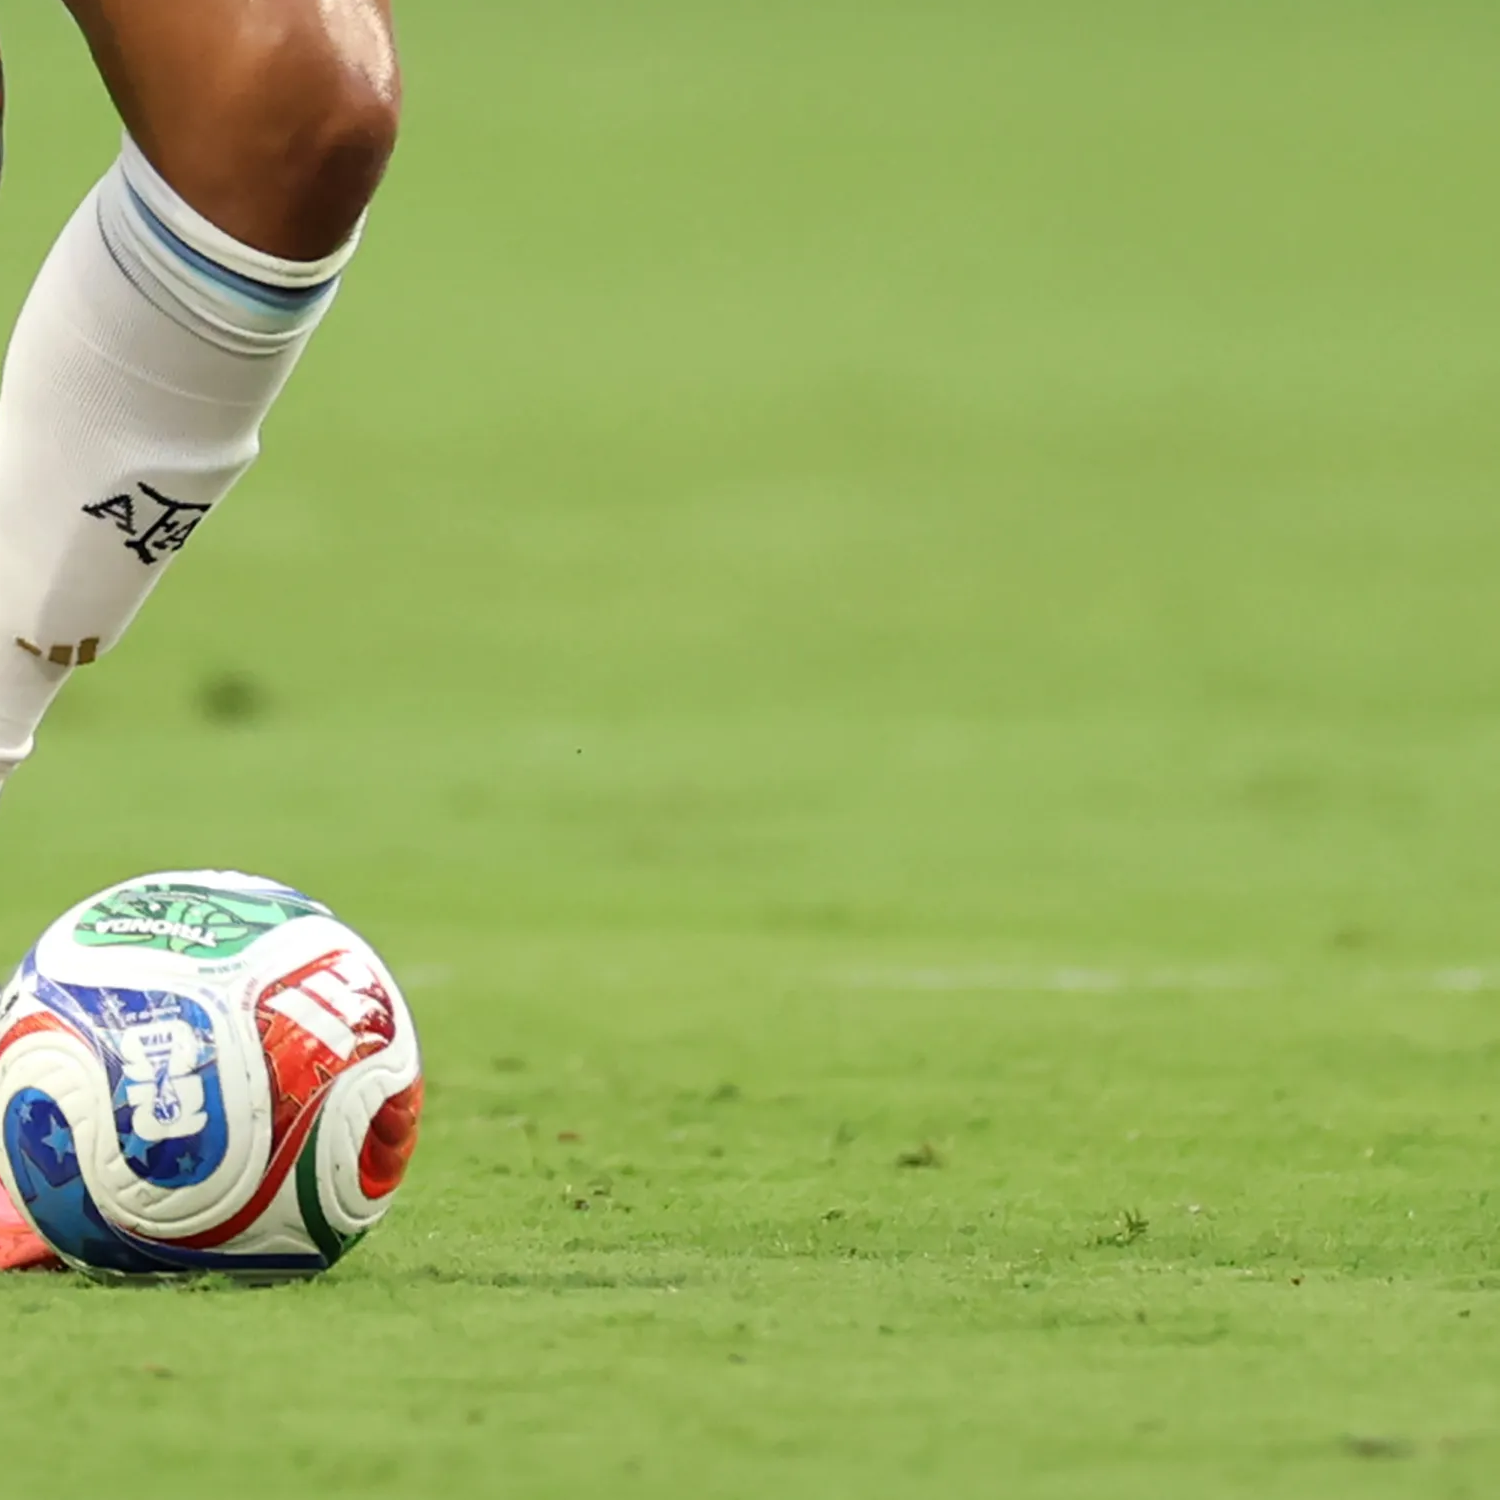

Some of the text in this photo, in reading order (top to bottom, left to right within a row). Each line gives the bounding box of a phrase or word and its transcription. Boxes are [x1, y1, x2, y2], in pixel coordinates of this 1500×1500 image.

[81, 481, 213, 565] AFA
[95, 917, 218, 948] TRIONDA
[139, 1032, 174, 1046] FIFA
